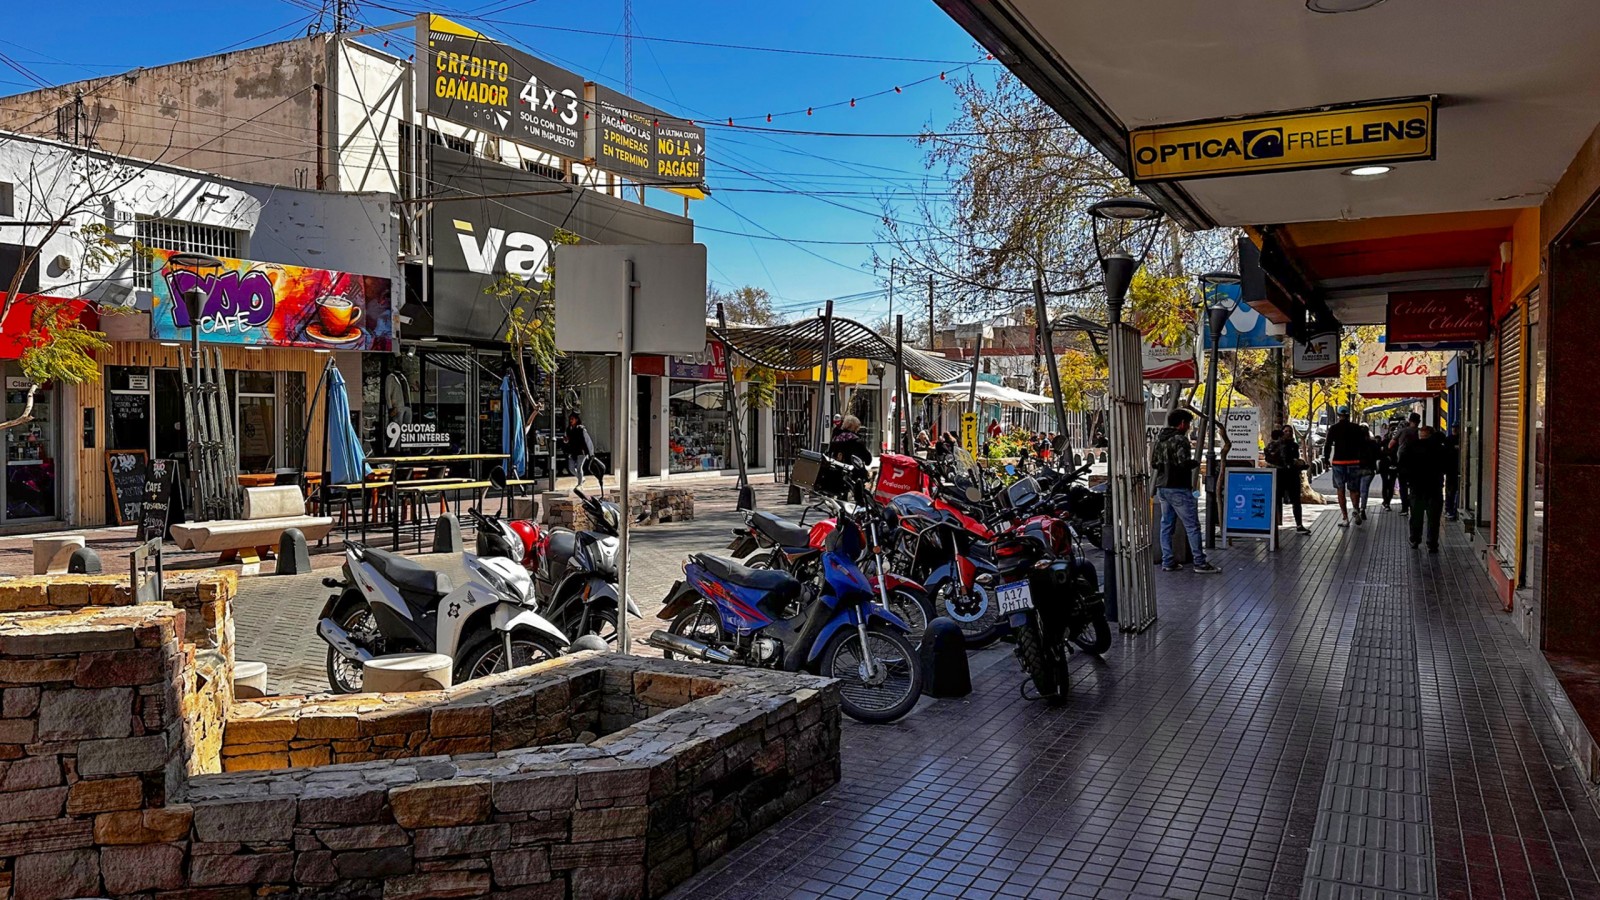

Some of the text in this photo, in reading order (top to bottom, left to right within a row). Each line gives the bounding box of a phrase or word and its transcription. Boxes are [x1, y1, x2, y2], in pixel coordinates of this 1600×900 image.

[436, 50, 509, 82] CREDITO
[435, 76, 509, 107] GANADOR
[520, 111, 578, 139] SOLO CON TU DNI
[601, 113, 651, 141] PAGANDO LAS
[666, 128, 683, 138] ÚLTIMA
[684, 132, 700, 140] CUOTA
[530, 126, 540, 136] UN
[541, 130, 575, 148] IMPUESTO
[603, 129, 649, 154] 3 PRIMERAS
[658, 138, 691, 156] NO LA
[603, 144, 649, 169] EN TERMINO
[1136, 137, 1242, 165] OPTICA
[658, 157, 699, 178] PAGÁS!!
[201, 311, 253, 334] CAFE
[1367, 355, 1430, 377] Lola
[386, 421, 401, 449] 9
[401, 423, 436, 433] CUOTAS
[401, 433, 450, 442] SIN INTERES
[145, 481, 162, 493] CAFE
[1234, 494, 1246, 509] 9
[1004, 587, 1023, 602] A17
